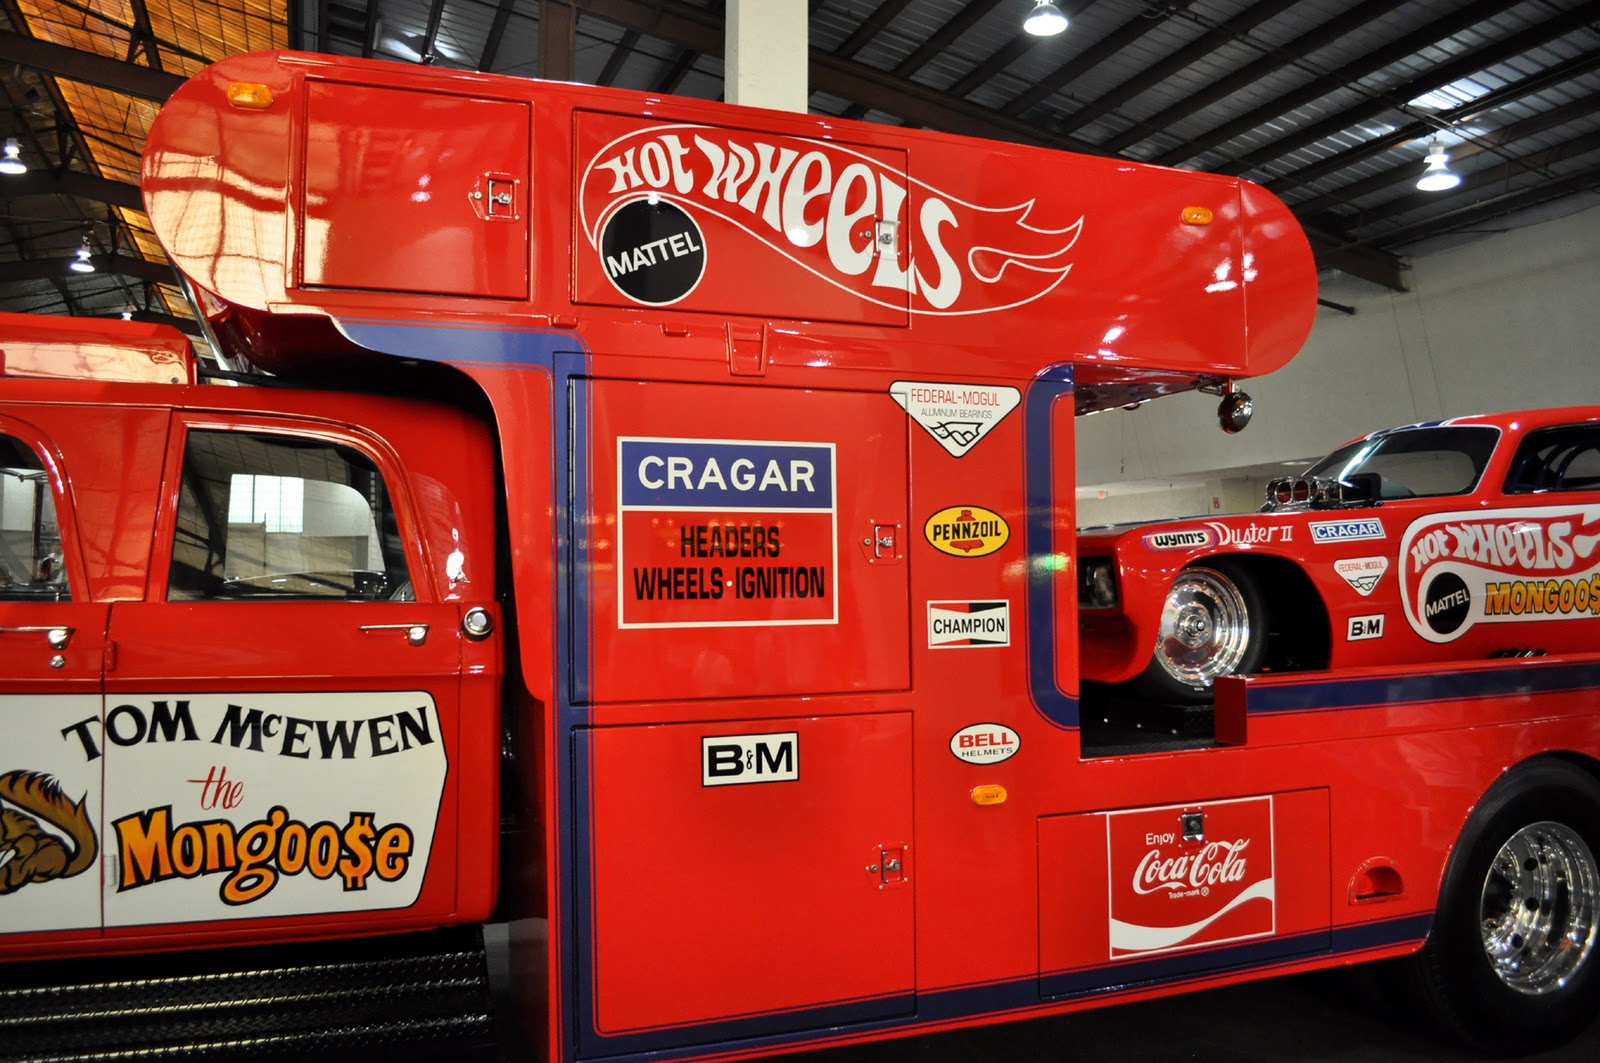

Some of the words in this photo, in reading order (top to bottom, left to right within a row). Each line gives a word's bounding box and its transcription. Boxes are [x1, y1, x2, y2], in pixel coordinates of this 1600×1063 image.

[606, 231, 700, 277] MATTEL
[911, 388, 1000, 406] FEDERAL-MOGUL
[920, 408, 958, 418] ALUMINUM
[959, 409, 992, 419] BEARINGS
[638, 455, 815, 492] CRAGAR
[680, 525, 780, 558] HEADERS
[933, 520, 1002, 541] PENNZOIL
[1203, 522, 1277, 546] Duster
[1279, 525, 1293, 543] II
[1315, 524, 1380, 539] CRAGAR
[1338, 561, 1384, 573] FEDERAL-MOGUL
[633, 568, 724, 601] WHEELS
[735, 566, 825, 599] IGNITION
[1425, 589, 1470, 617] MATTEL
[933, 618, 1005, 635] CHAMPION
[1351, 621, 1380, 637] B&M
[61, 701, 200, 762] TOM
[959, 732, 1014, 749] BELL
[708, 741, 793, 778] B&M
[961, 747, 1013, 757] HELMETS
[186, 765, 246, 811] the
[1145, 832, 1175, 846] Enjoy
[111, 804, 414, 906] Mongoo$e
[1132, 838, 1250, 895] Coca-Cola
